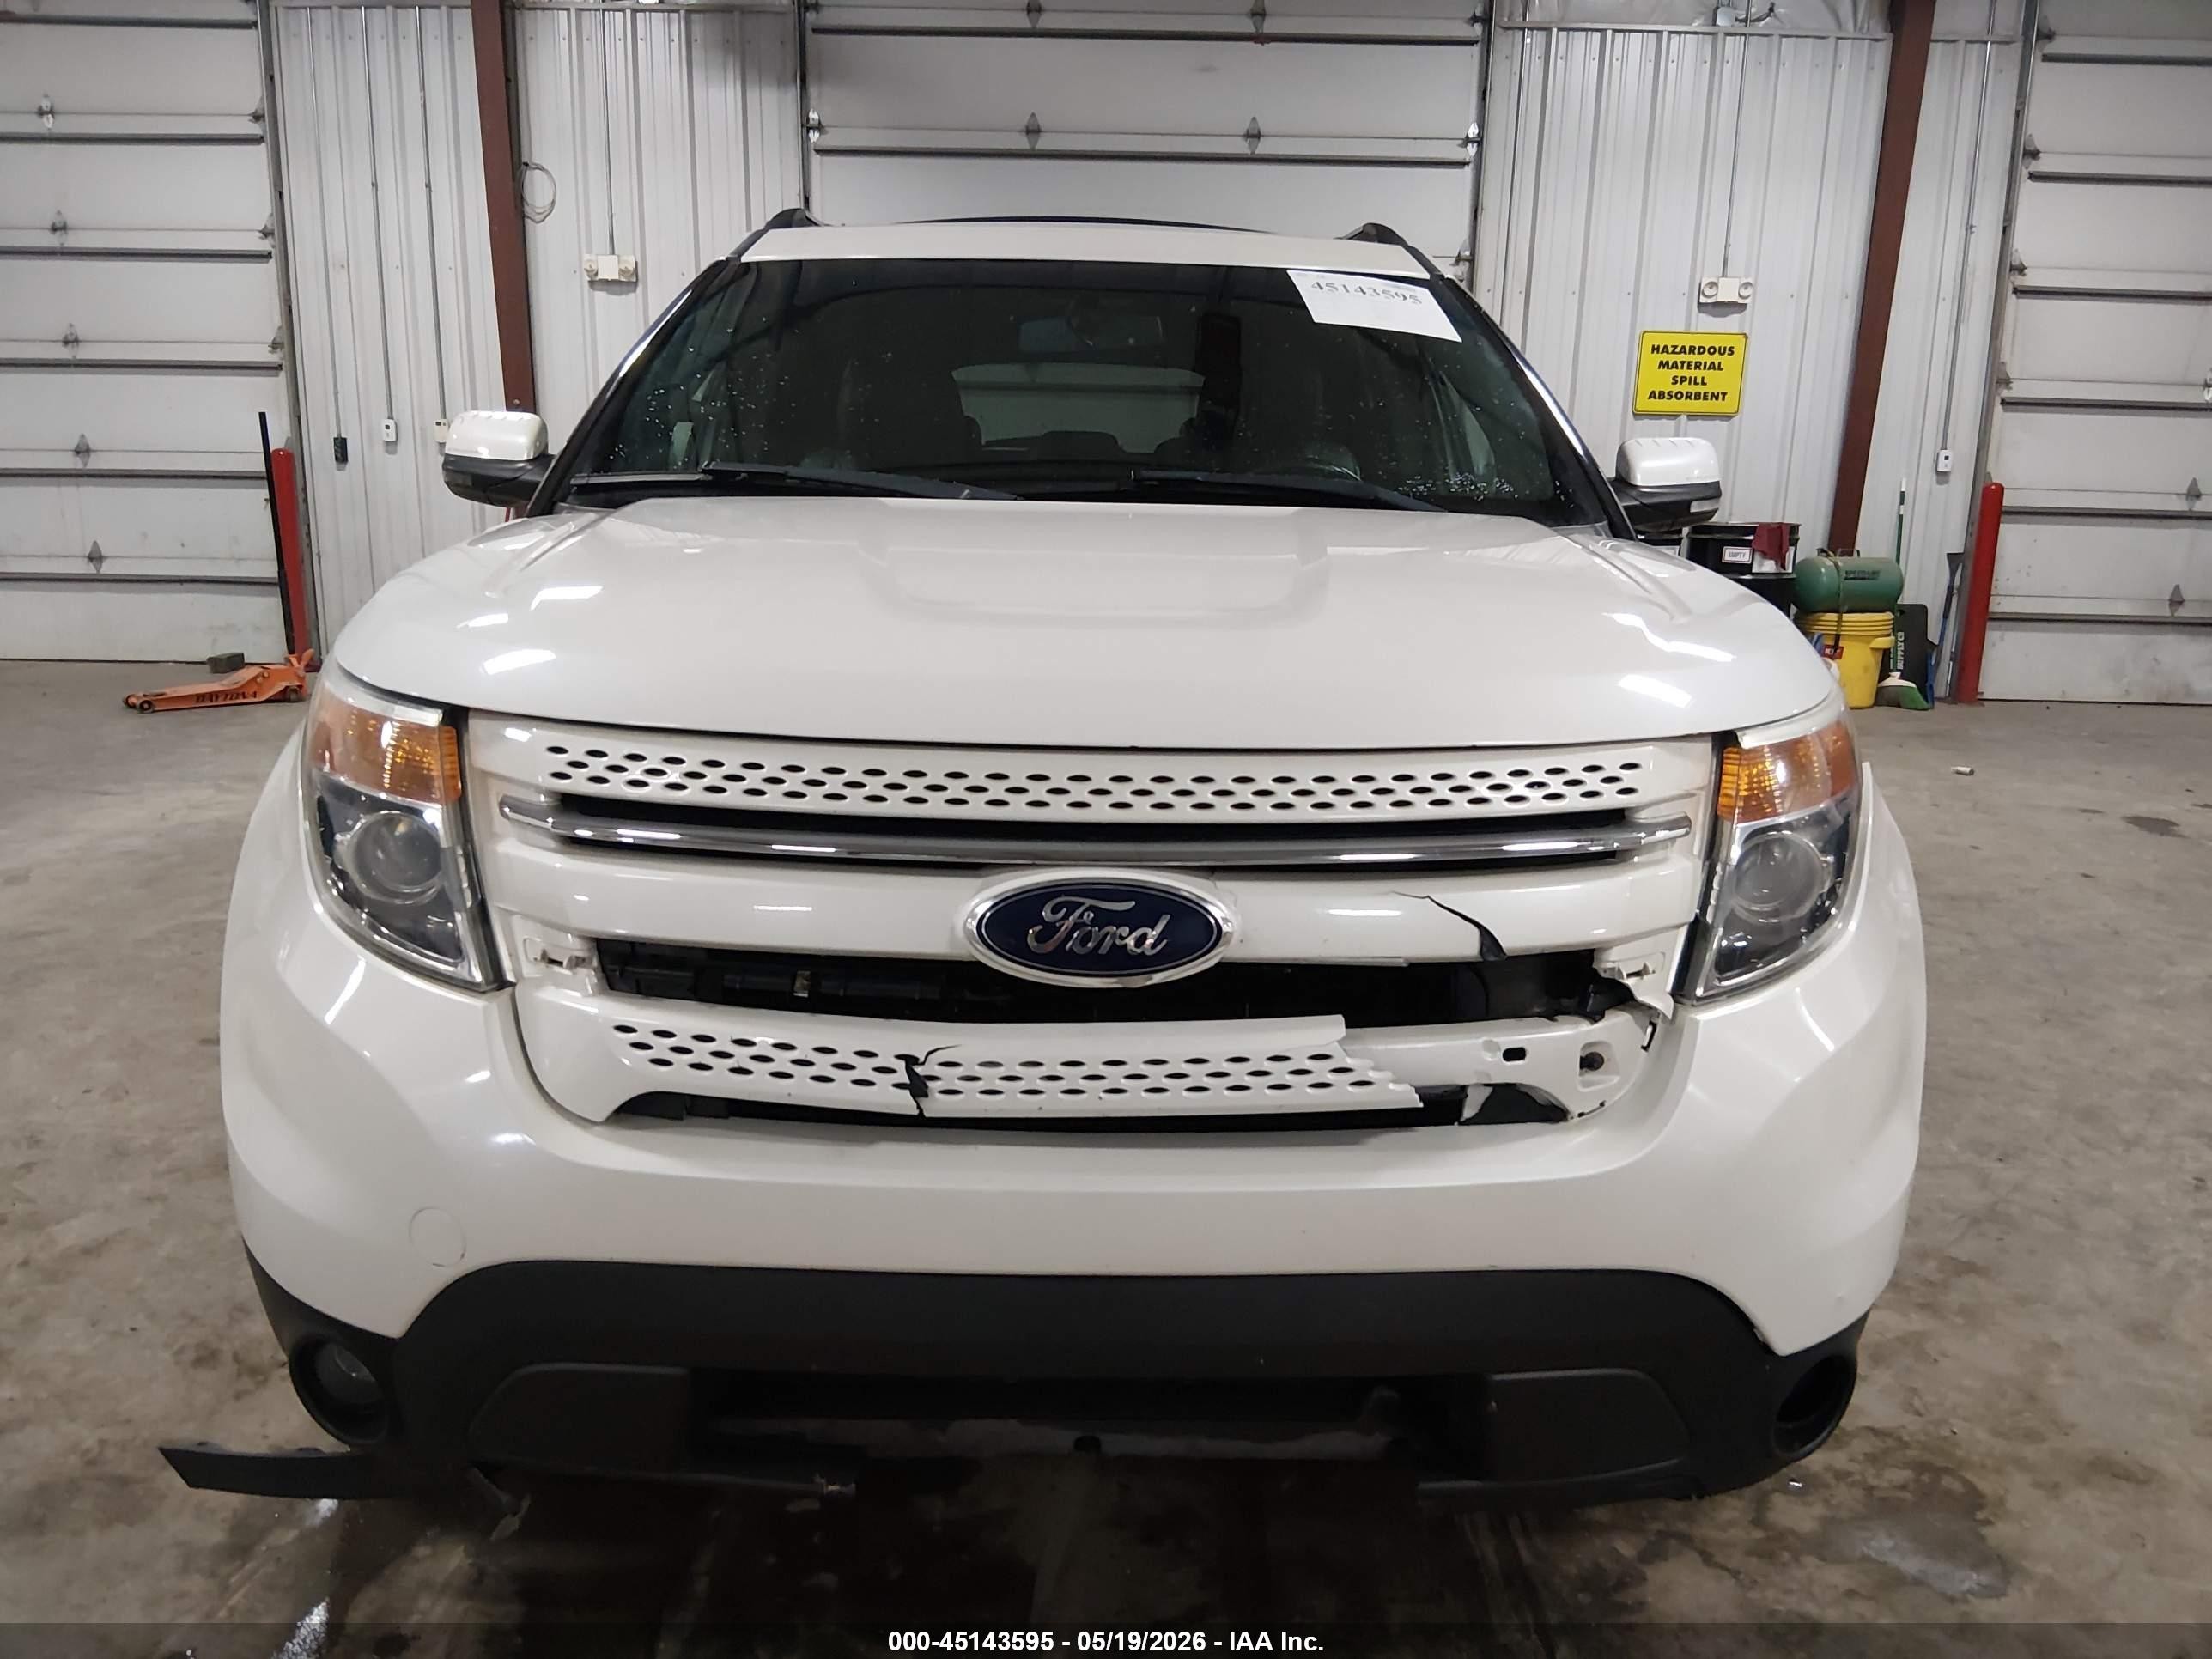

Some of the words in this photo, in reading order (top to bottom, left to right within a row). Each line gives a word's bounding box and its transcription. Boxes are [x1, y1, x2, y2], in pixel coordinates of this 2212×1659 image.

[1311, 281, 1423, 304] 45143595
[1650, 344, 1735, 356] HAZARDOUS
[1657, 360, 1724, 371] MATERIAL
[1671, 375, 1708, 386] SPILL
[1648, 390, 1728, 402] ABSORBENT
[1027, 896, 1171, 957] Ford
